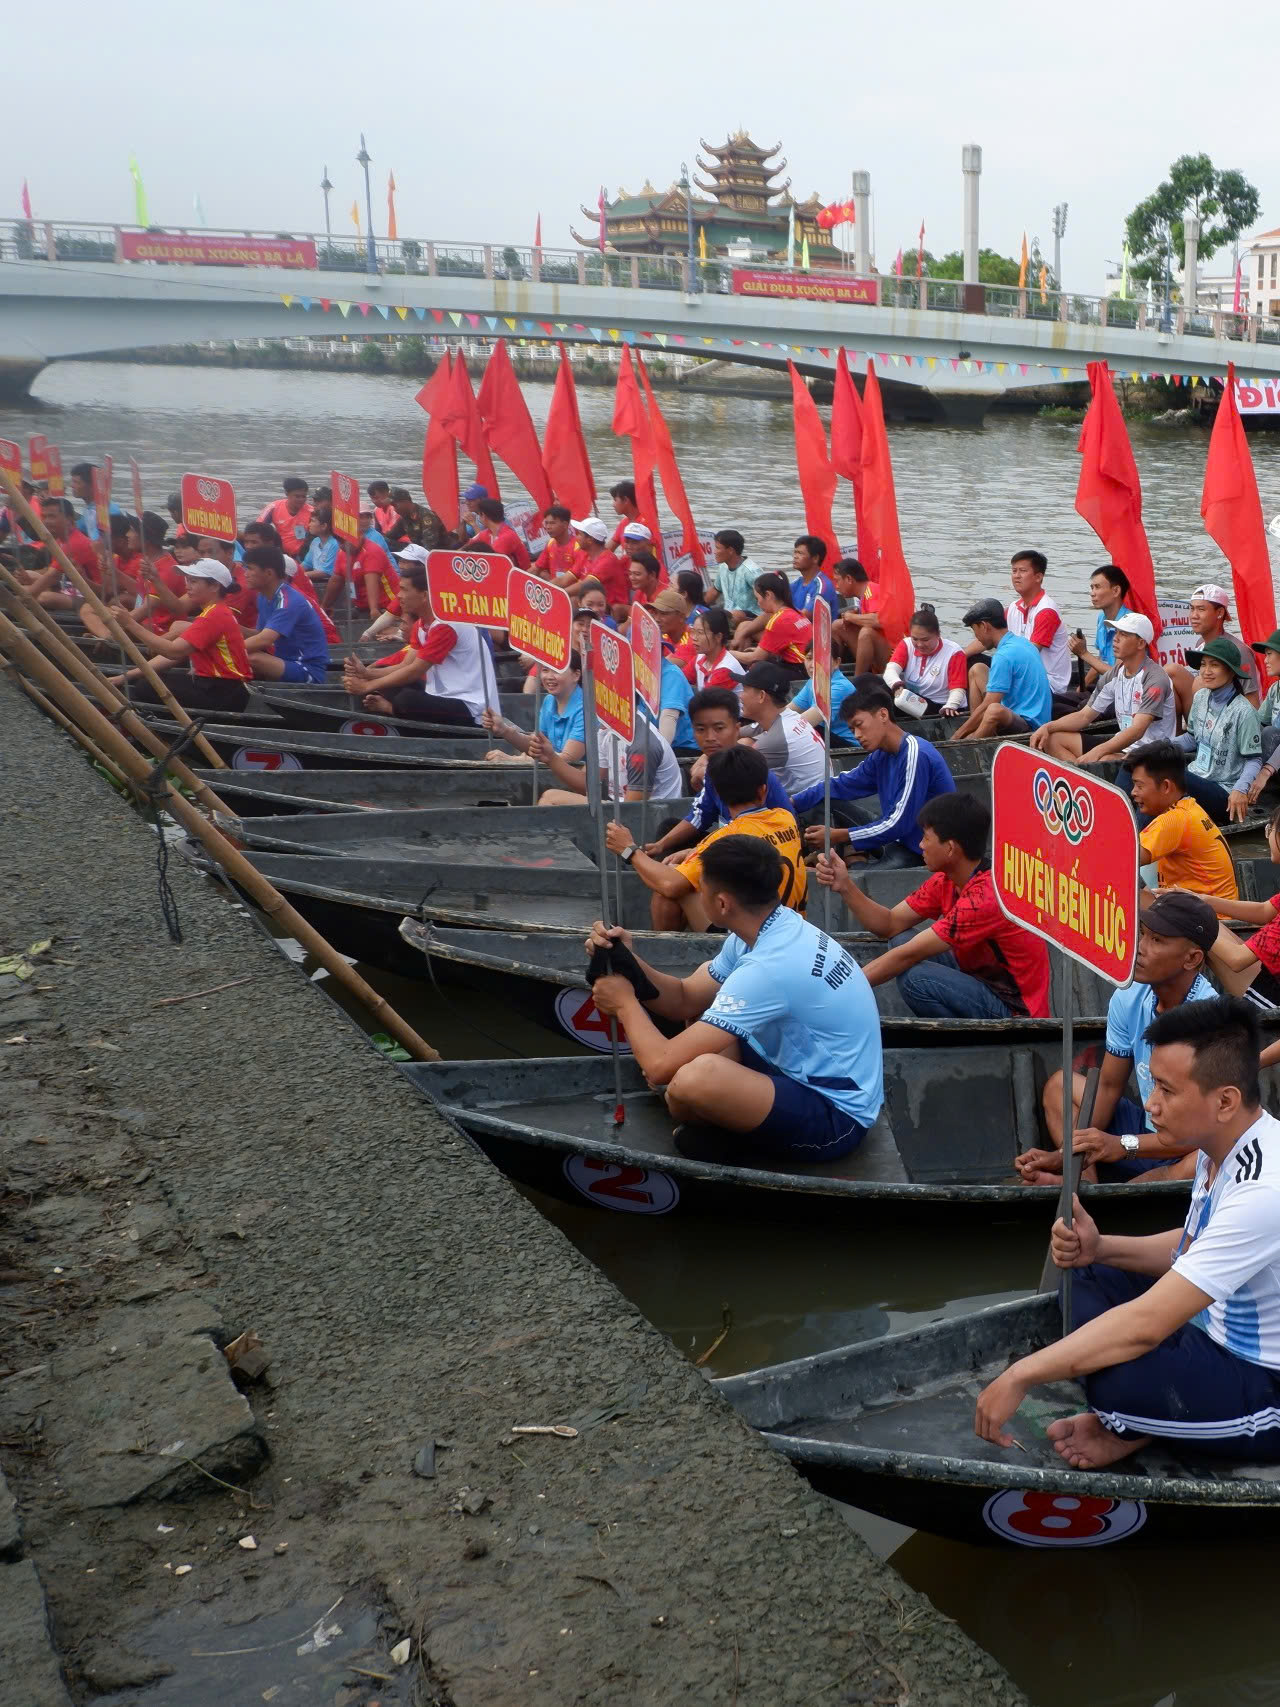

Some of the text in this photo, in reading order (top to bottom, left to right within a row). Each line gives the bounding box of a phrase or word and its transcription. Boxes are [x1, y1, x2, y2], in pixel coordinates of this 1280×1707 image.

[262, 250, 282, 262] BA
[770, 283, 794, 294] ĐUA
[837, 288, 851, 298] BA
[440, 590, 508, 618] TP. TÂN AN
[510, 614, 532, 648] HUYỆN
[1004, 842, 1126, 960] HUYỆN BẾN LỨC
[824, 958, 853, 990] HUYỆN
[571, 995, 628, 1042] 4
[584, 1158, 653, 1205] 2
[1008, 1492, 1118, 1538] 8
